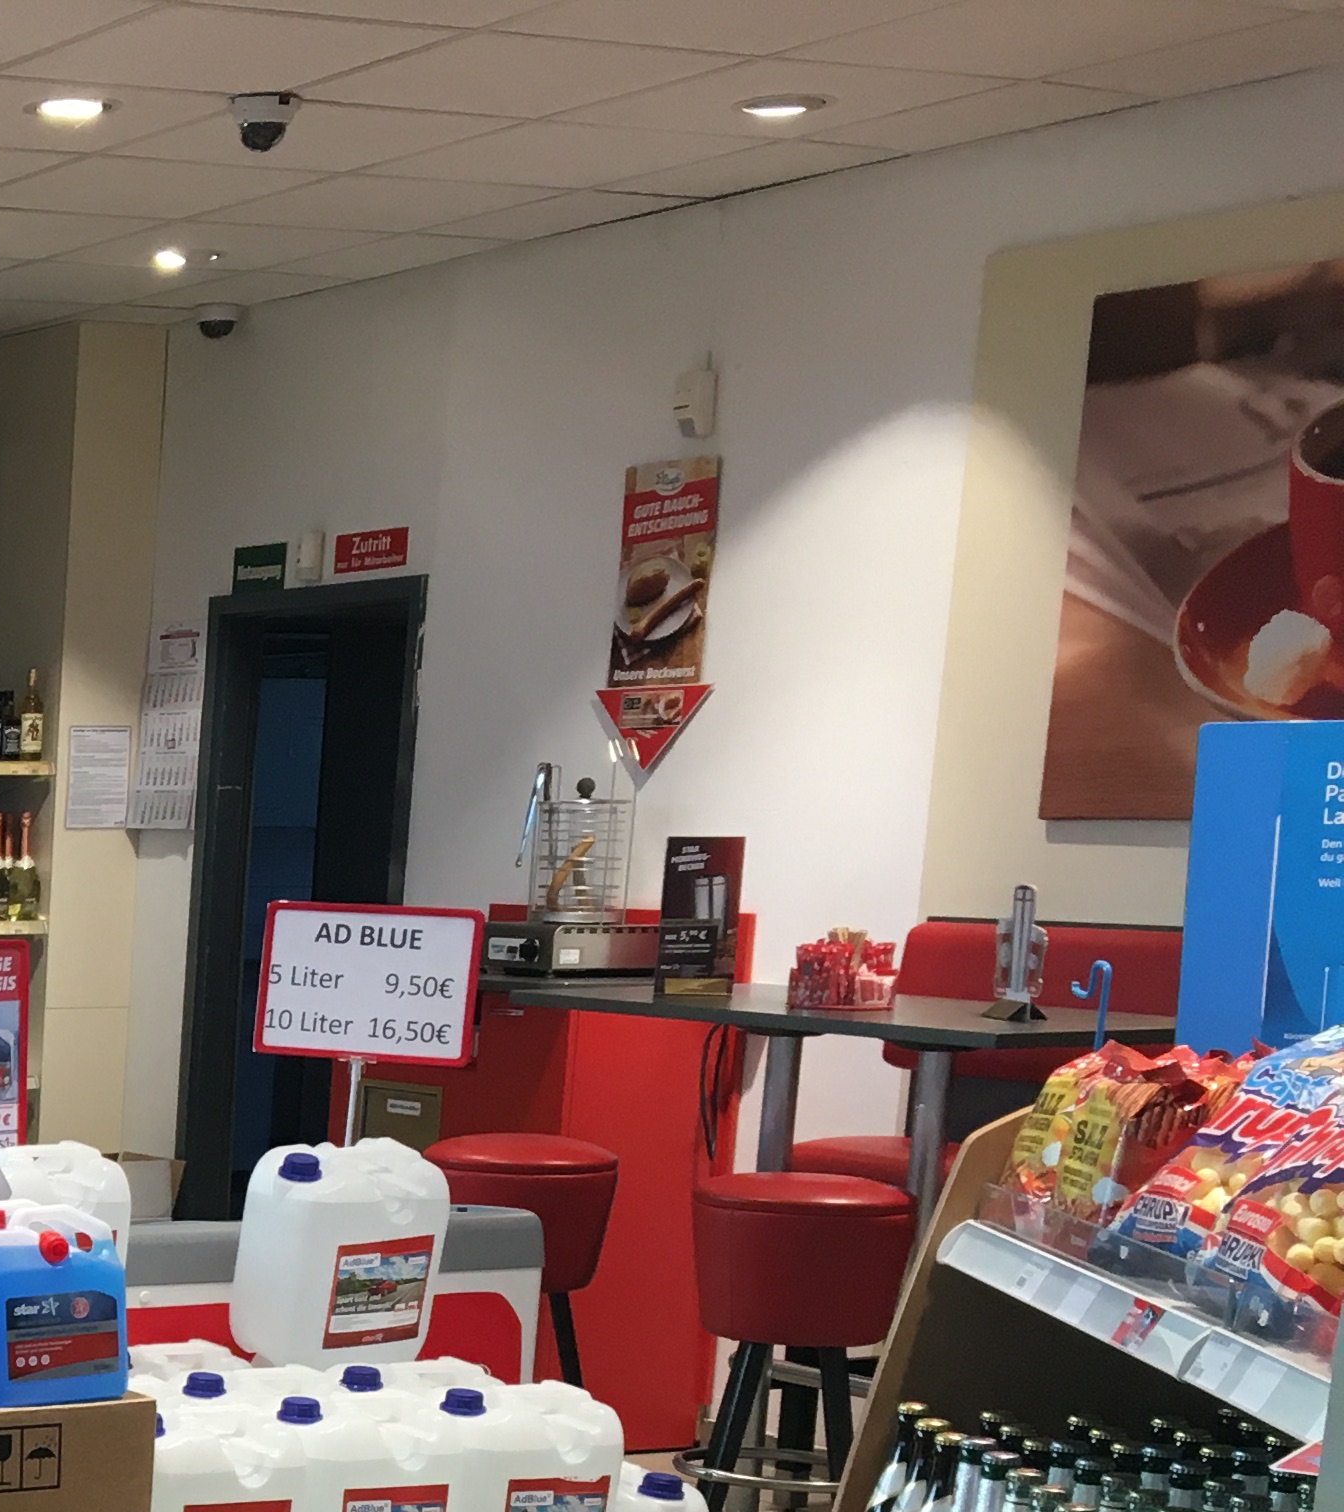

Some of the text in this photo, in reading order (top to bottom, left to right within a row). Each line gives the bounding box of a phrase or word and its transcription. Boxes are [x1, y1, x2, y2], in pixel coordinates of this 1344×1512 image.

[633, 501, 662, 519] GUTE
[628, 509, 709, 538] ENTSCHEIDUNG
[351, 533, 392, 555] Zutritt
[352, 554, 404, 567] für Mitarbeiter
[613, 666, 696, 681] Unsere Bockwurst
[1321, 839, 1342, 849] Den
[1318, 878, 1341, 887] Weil
[314, 923, 423, 950] AD BLUE
[268, 964, 455, 999] 5 Liter 9,50€
[265, 1009, 452, 1045] 10 Liter 16,50€
[14, 1305, 40, 1316] star
